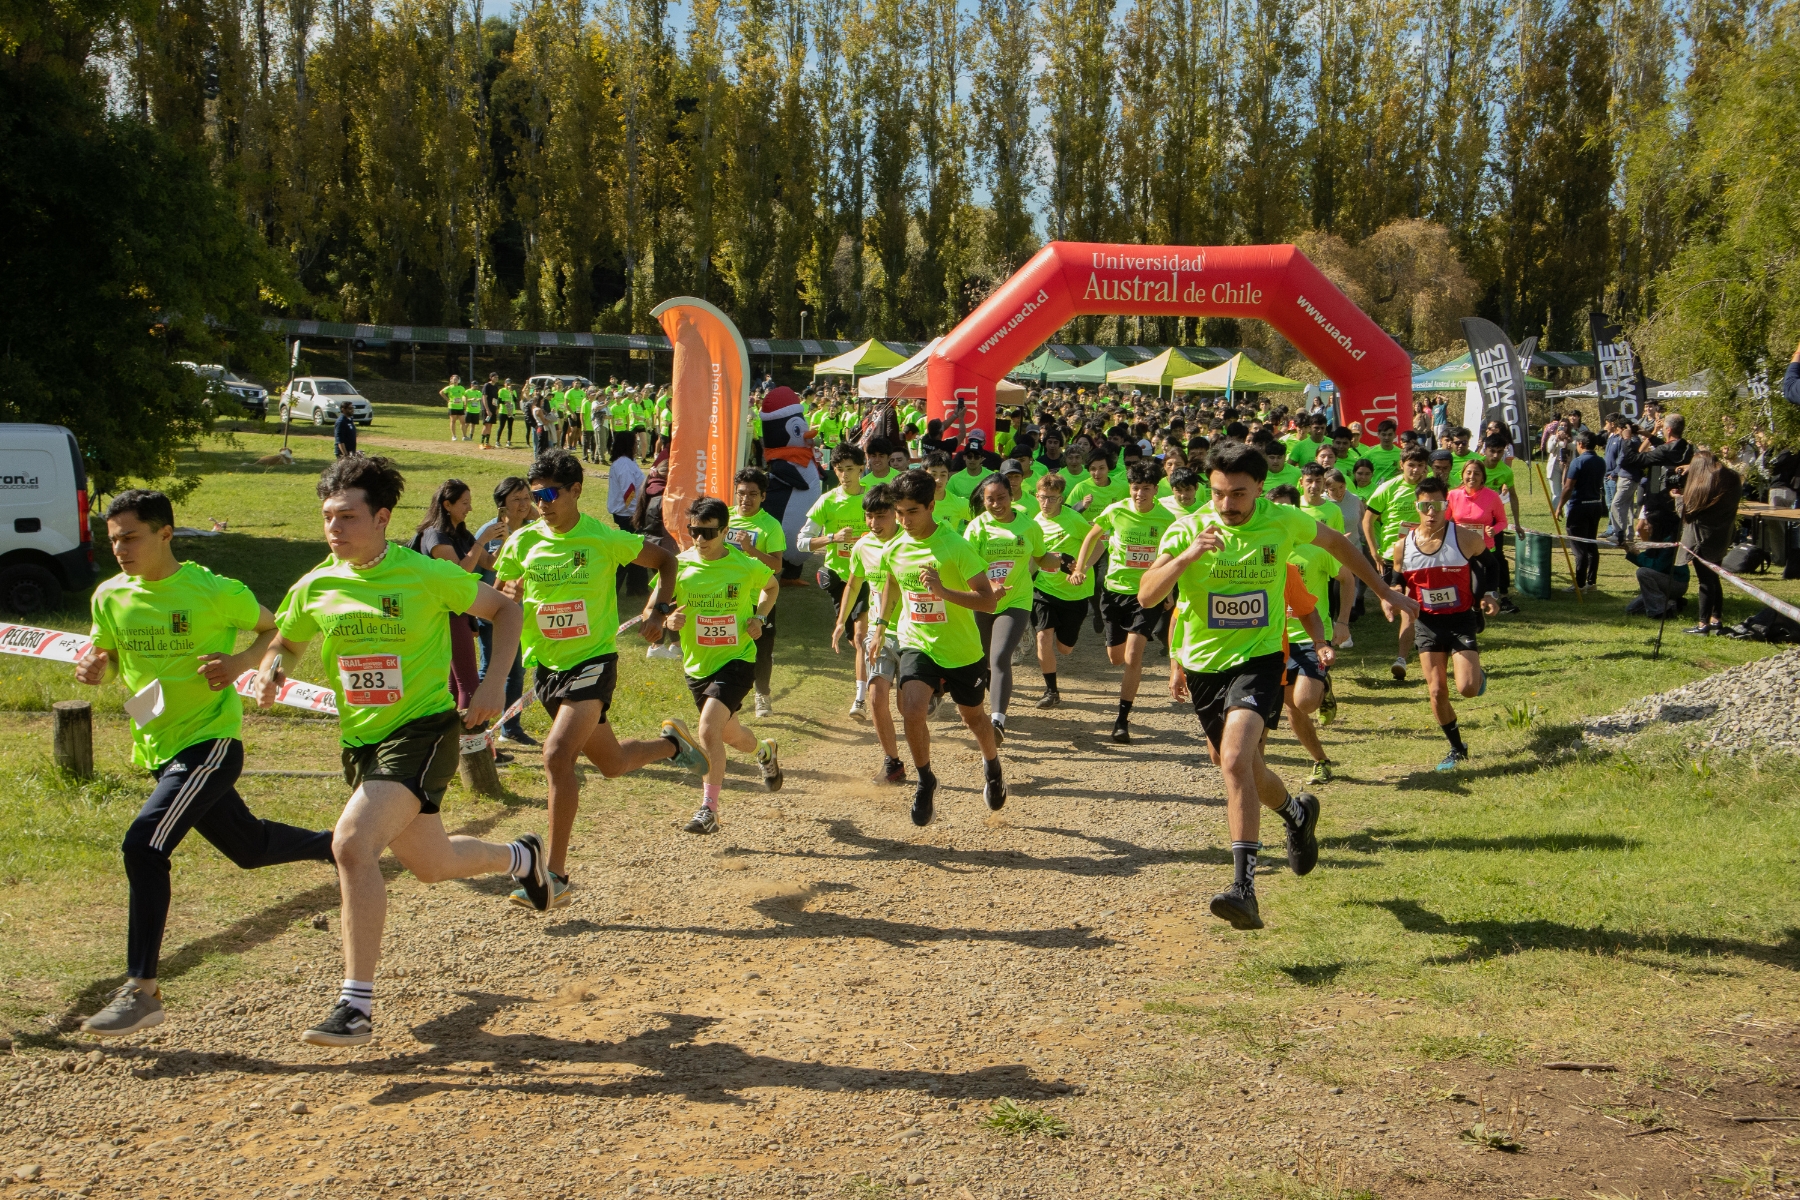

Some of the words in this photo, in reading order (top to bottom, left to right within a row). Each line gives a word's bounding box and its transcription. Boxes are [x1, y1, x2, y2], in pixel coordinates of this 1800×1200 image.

[1092, 252, 1203, 272] Universidad
[1083, 271, 1179, 303] Austral
[1183, 281, 1207, 303] de
[1211, 282, 1263, 304] Chile
[977, 289, 1050, 354] www.uach.cl
[1296, 294, 1367, 362] www.uach.cl
[1132, 552, 1149, 562] 570
[528, 569, 561, 583] Austral
[990, 568, 1008, 579] 158
[1208, 565, 1248, 579] Austral
[1248, 568, 1259, 579] de
[1260, 567, 1278, 579] Chile
[686, 598, 715, 608] Austral
[715, 601, 723, 609] de
[1429, 591, 1451, 603] 581
[914, 602, 934, 614] 287
[1215, 598, 1262, 616] 0800
[546, 613, 574, 629] 707
[699, 616, 713, 624] TRAIL
[366, 622, 378, 635] de
[380, 623, 406, 636] Chile
[703, 625, 728, 637] 235
[2, 628, 46, 649] PELIGRO
[157, 640, 168, 651] de
[169, 638, 195, 651] Chile
[340, 658, 363, 668] TRAIL
[386, 658, 397, 667] 6K
[350, 671, 385, 690] 283
